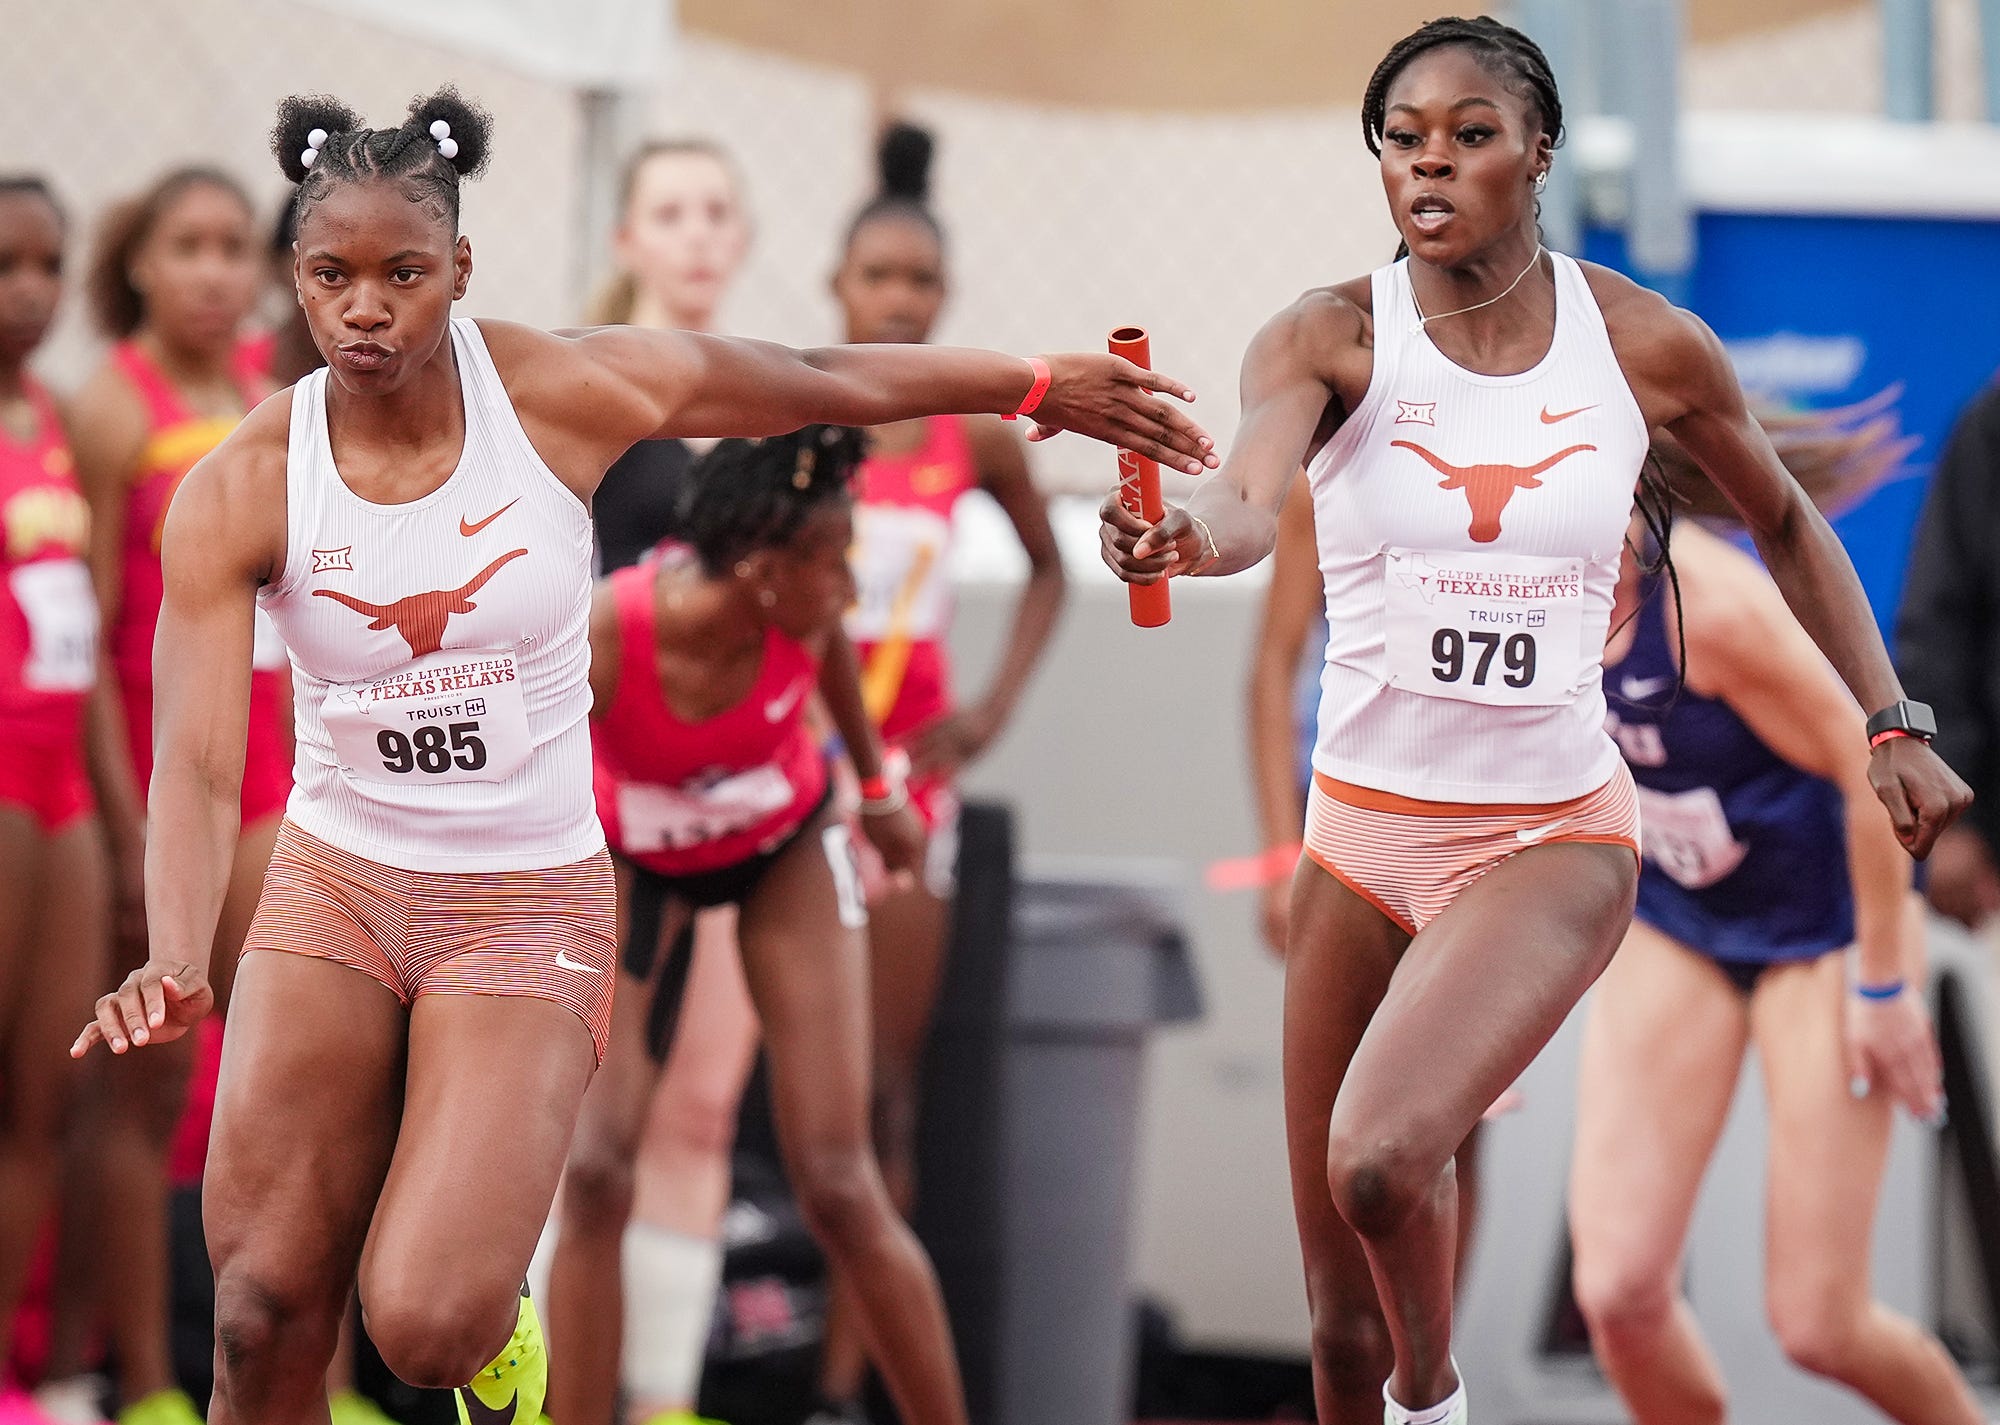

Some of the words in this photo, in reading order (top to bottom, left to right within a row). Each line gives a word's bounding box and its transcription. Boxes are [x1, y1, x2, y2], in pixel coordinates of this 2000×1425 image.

[1437, 569, 1483, 581] CLYDE
[1489, 573, 1580, 585] LITTLEFIELD
[1437, 580, 1503, 597] TEXAS
[1508, 584, 1580, 599] RELAYS
[1469, 609, 1524, 624] TRUIST
[1431, 628, 1537, 689] 979
[370, 679, 437, 702] TEXAS
[439, 668, 516, 692] RELAYS
[372, 672, 414, 689] CLYDE
[419, 658, 514, 680] LITTLEFIELD
[406, 704, 462, 721] TRUIST
[376, 721, 487, 774] 985
